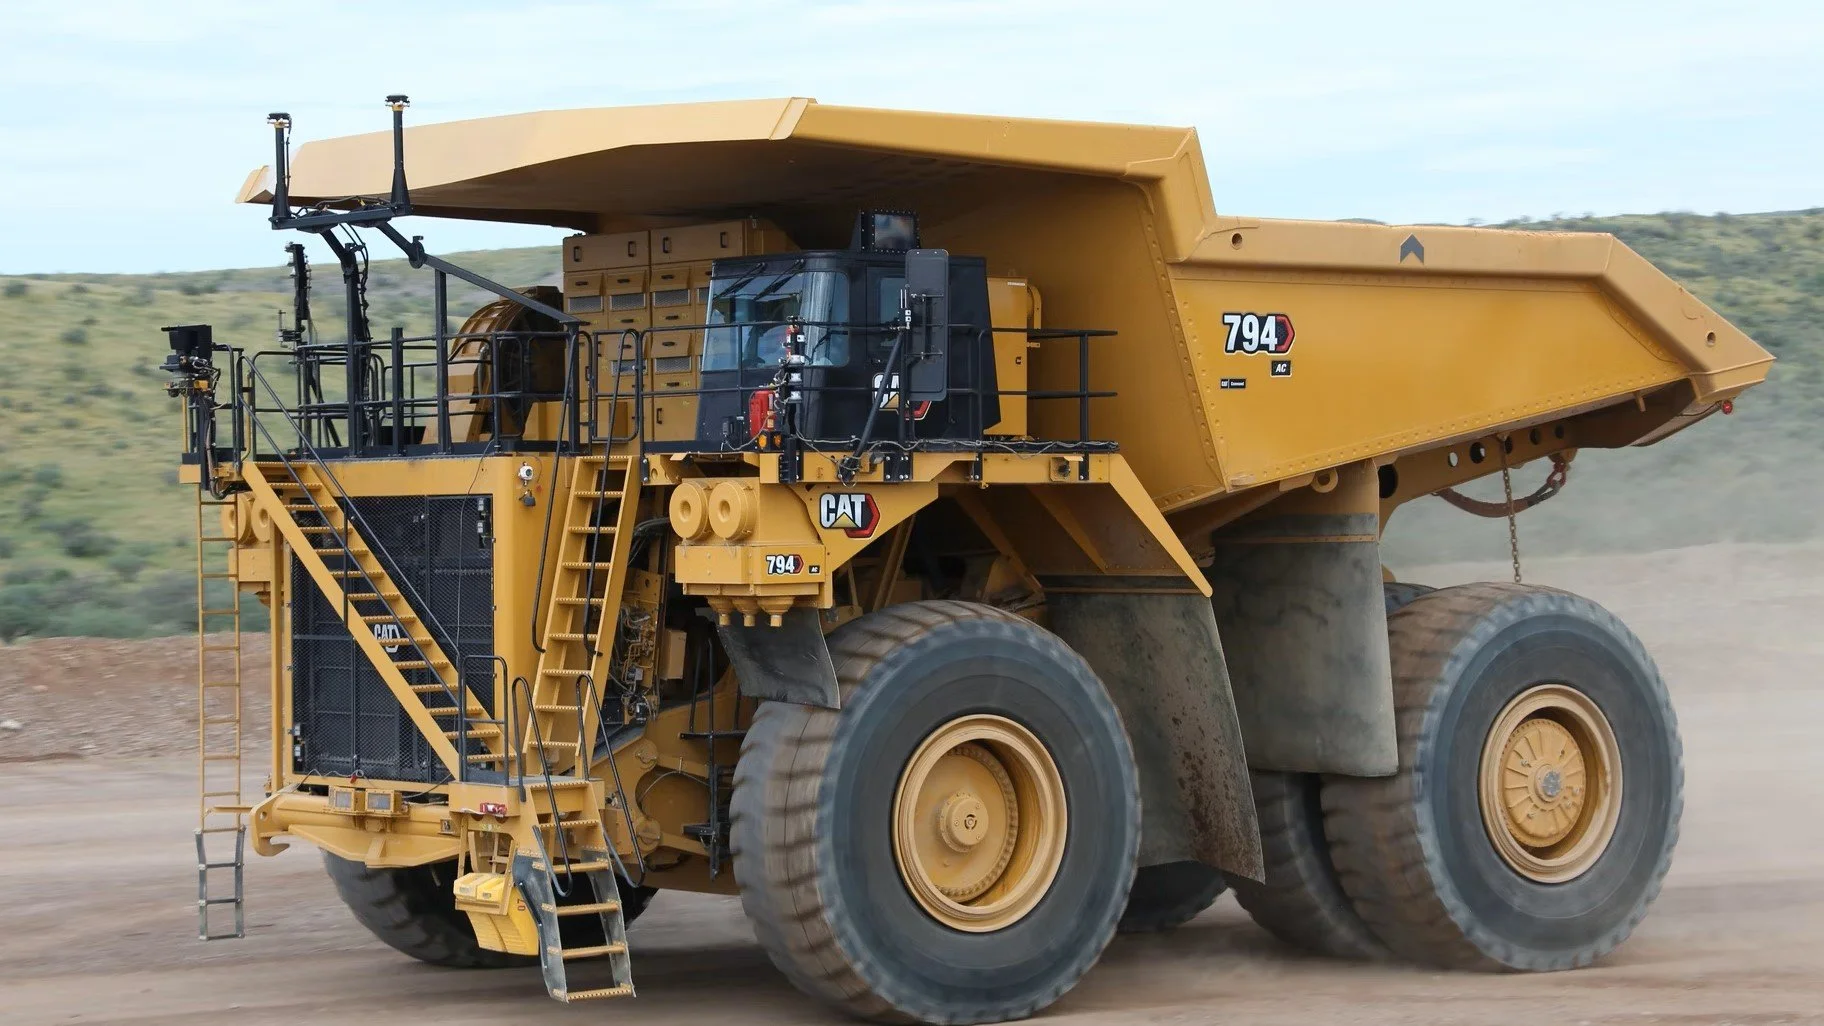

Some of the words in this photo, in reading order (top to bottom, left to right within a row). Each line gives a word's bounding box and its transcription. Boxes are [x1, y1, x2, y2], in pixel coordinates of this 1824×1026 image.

[1224, 314, 1278, 351] 794
[1275, 363, 1287, 373] AC
[820, 493, 866, 528] CAT
[766, 555, 795, 574] 794
